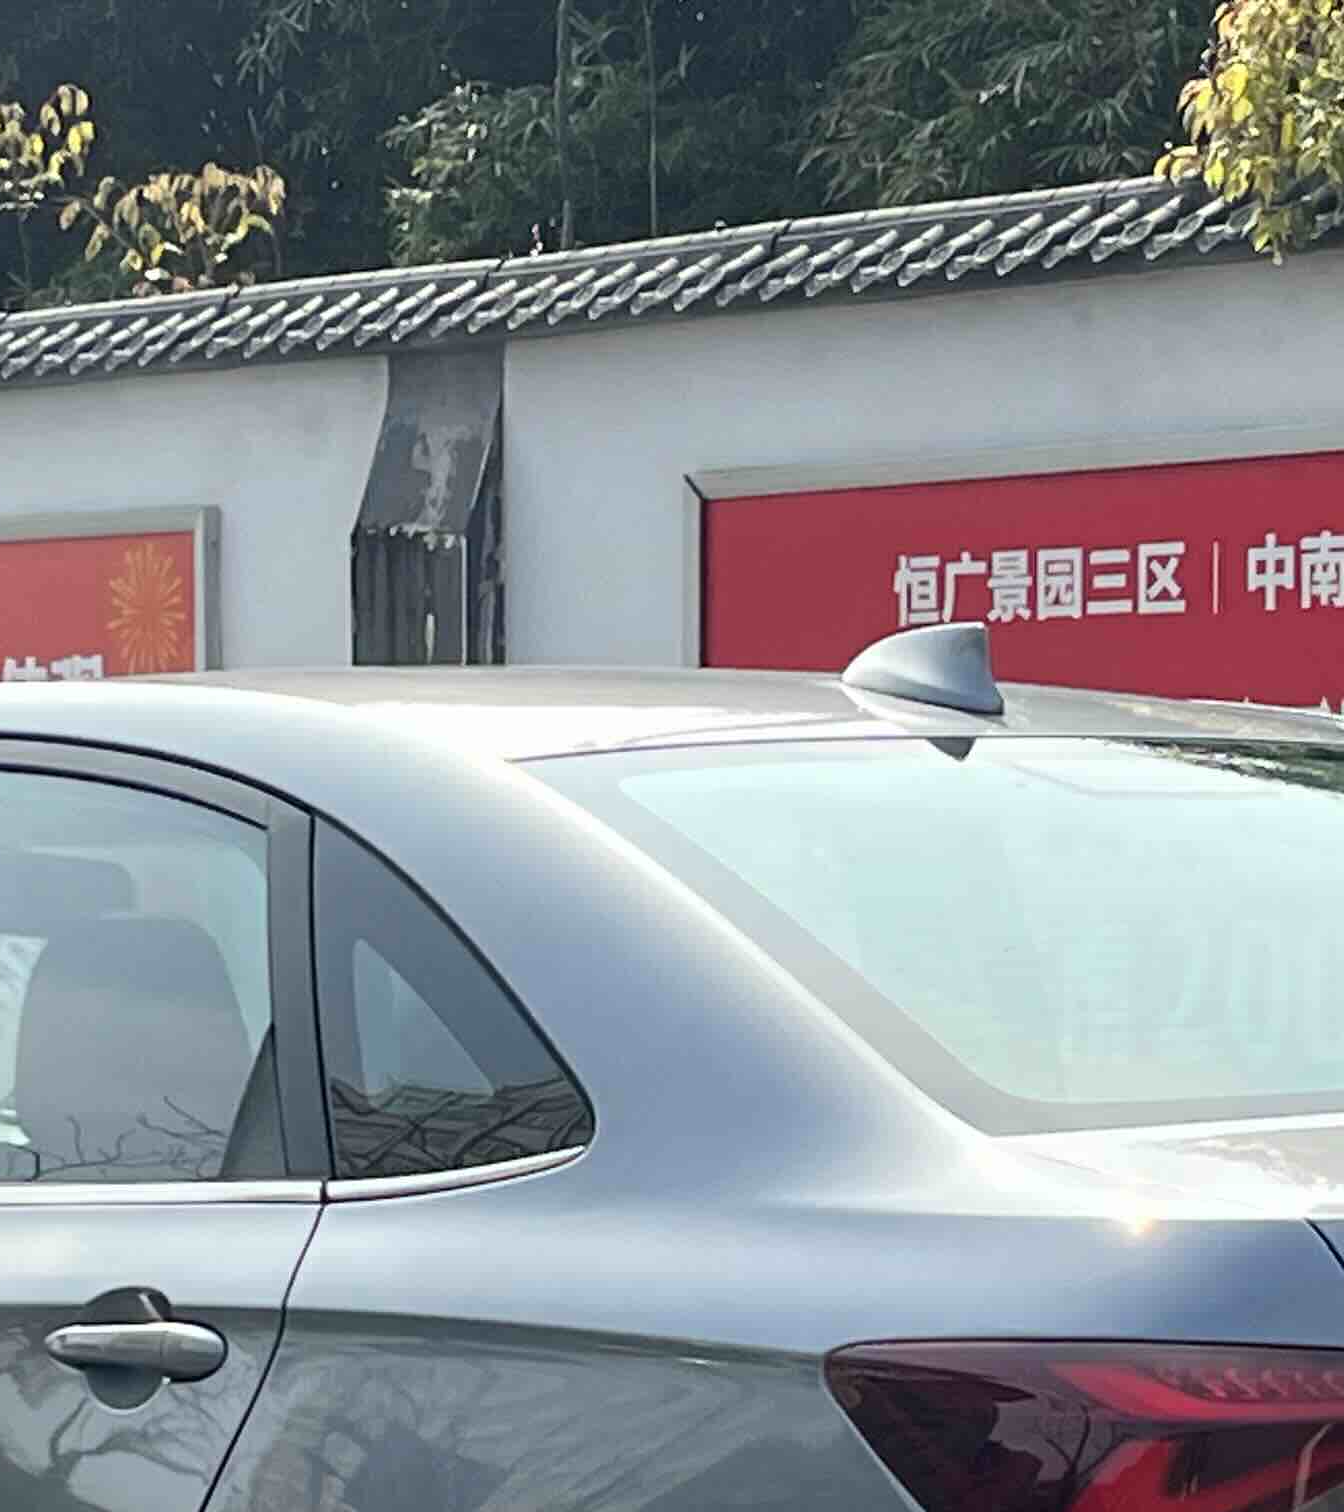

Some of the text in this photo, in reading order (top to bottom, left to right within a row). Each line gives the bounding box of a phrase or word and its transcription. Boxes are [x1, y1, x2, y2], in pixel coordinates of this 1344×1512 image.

[894, 541, 1186, 627] 恒广景园三区
